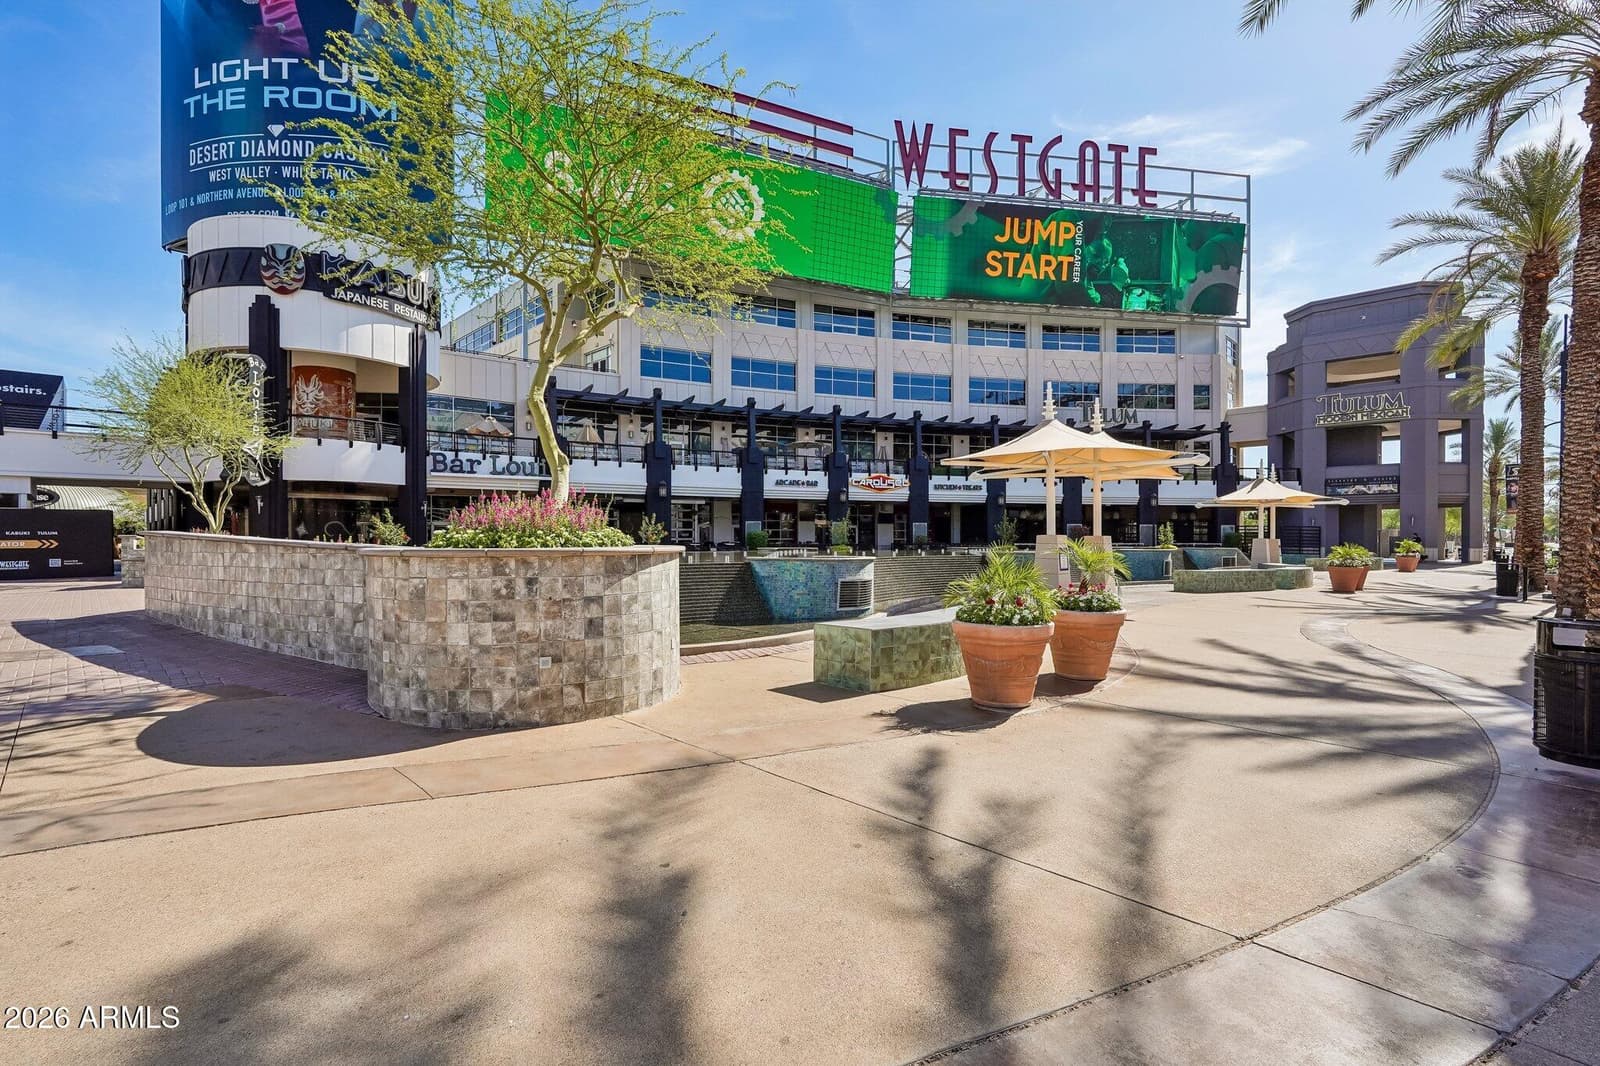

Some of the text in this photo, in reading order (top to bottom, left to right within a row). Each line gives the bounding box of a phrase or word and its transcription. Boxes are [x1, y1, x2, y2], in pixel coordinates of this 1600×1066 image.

[194, 58, 379, 89] LIGHT UP
[184, 86, 397, 121] THE ROOM
[189, 142, 235, 166] DESERT
[241, 140, 315, 157] DIAMOND
[894, 120, 1157, 207] WESTGATE
[209, 168, 231, 183] WEST
[235, 166, 270, 179] VALLEY
[282, 166, 319, 179] WHIE
[165, 202, 177, 216] LOOP
[190, 197, 194, 206] &
[197, 189, 233, 204] NORTHERN
[236, 187, 270, 198] AVENUE
[994, 217, 1075, 246] JUMP
[985, 250, 1074, 281] START
[1072, 220, 1084, 283] YOUR CAREER
[321, 251, 435, 310] KABUK
[331, 288, 438, 330] JAPANESE RESTAUR
[248, 356, 266, 370] Bar
[0, 384, 47, 396] stairs.
[1316, 392, 1403, 415] TULUM
[1359, 407, 1410, 422] MEXICAN
[431, 452, 550, 477] Bar Loui
[852, 477, 911, 489] CAROUSEL
